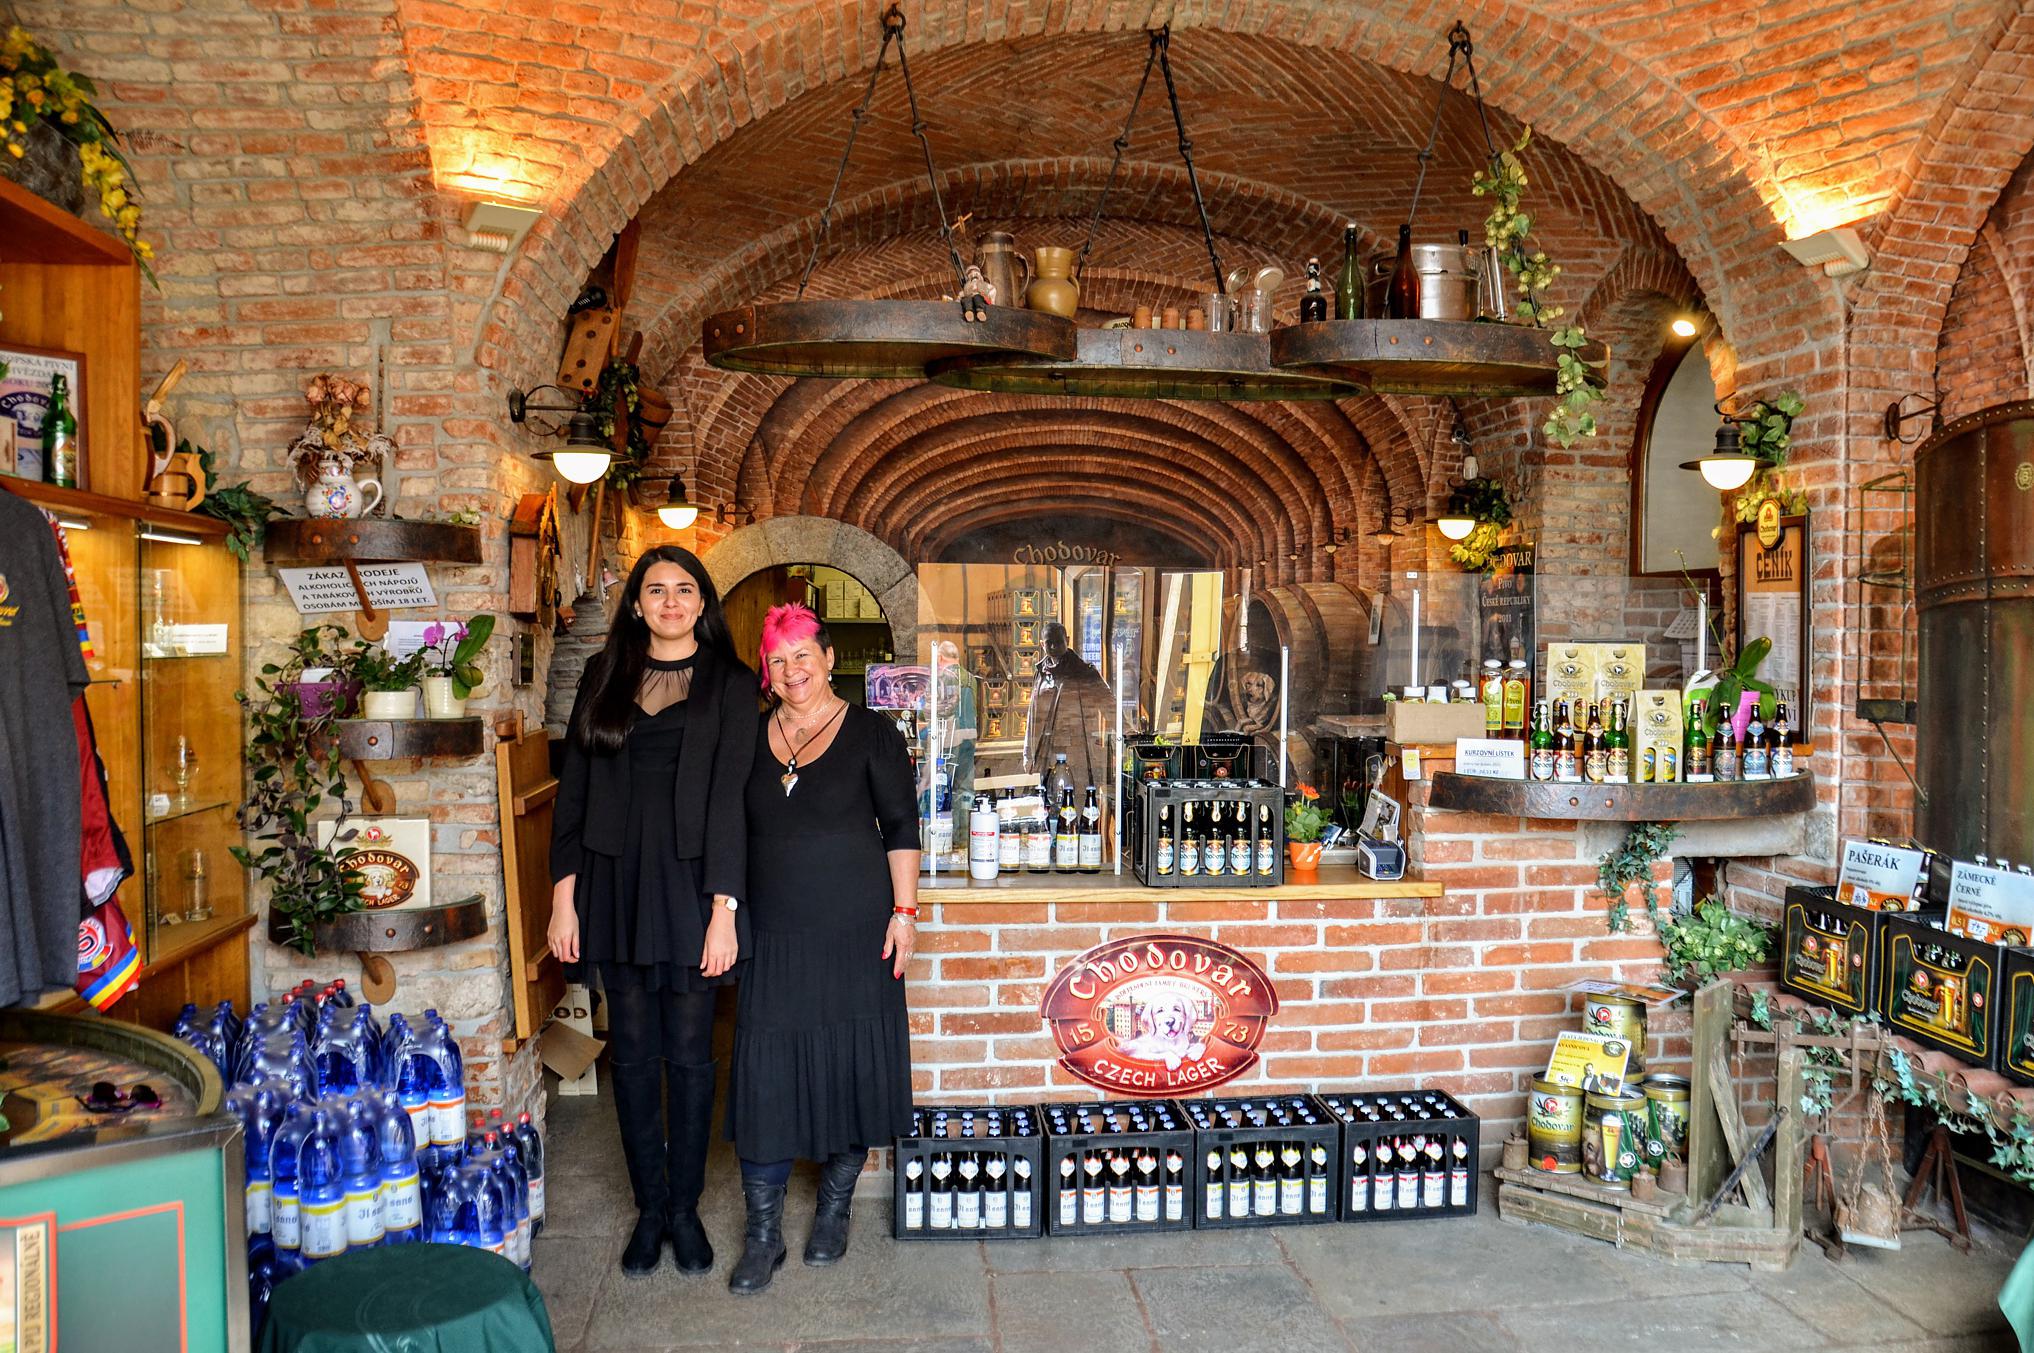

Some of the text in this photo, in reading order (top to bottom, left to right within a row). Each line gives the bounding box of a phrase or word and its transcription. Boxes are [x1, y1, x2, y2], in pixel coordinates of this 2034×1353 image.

[1013, 541, 1121, 567] Chodovar
[1756, 547, 1793, 578] CENÍK
[308, 571, 346, 581] ZÁKAZ
[379, 577, 418, 587] NÁPOJŮ
[377, 586, 423, 596] VÝROBKŮ
[303, 601, 346, 610] OSOBÁM
[1848, 849, 1901, 871] PAŠERÁK
[1957, 869, 1997, 886] ZÁMECKÉ
[1955, 883, 1982, 897] ČERNÉ
[1069, 943, 1252, 999] Chodovar
[1068, 1021, 1250, 1046] 15 73
[1093, 1056, 1226, 1087] CZECH LAGER
